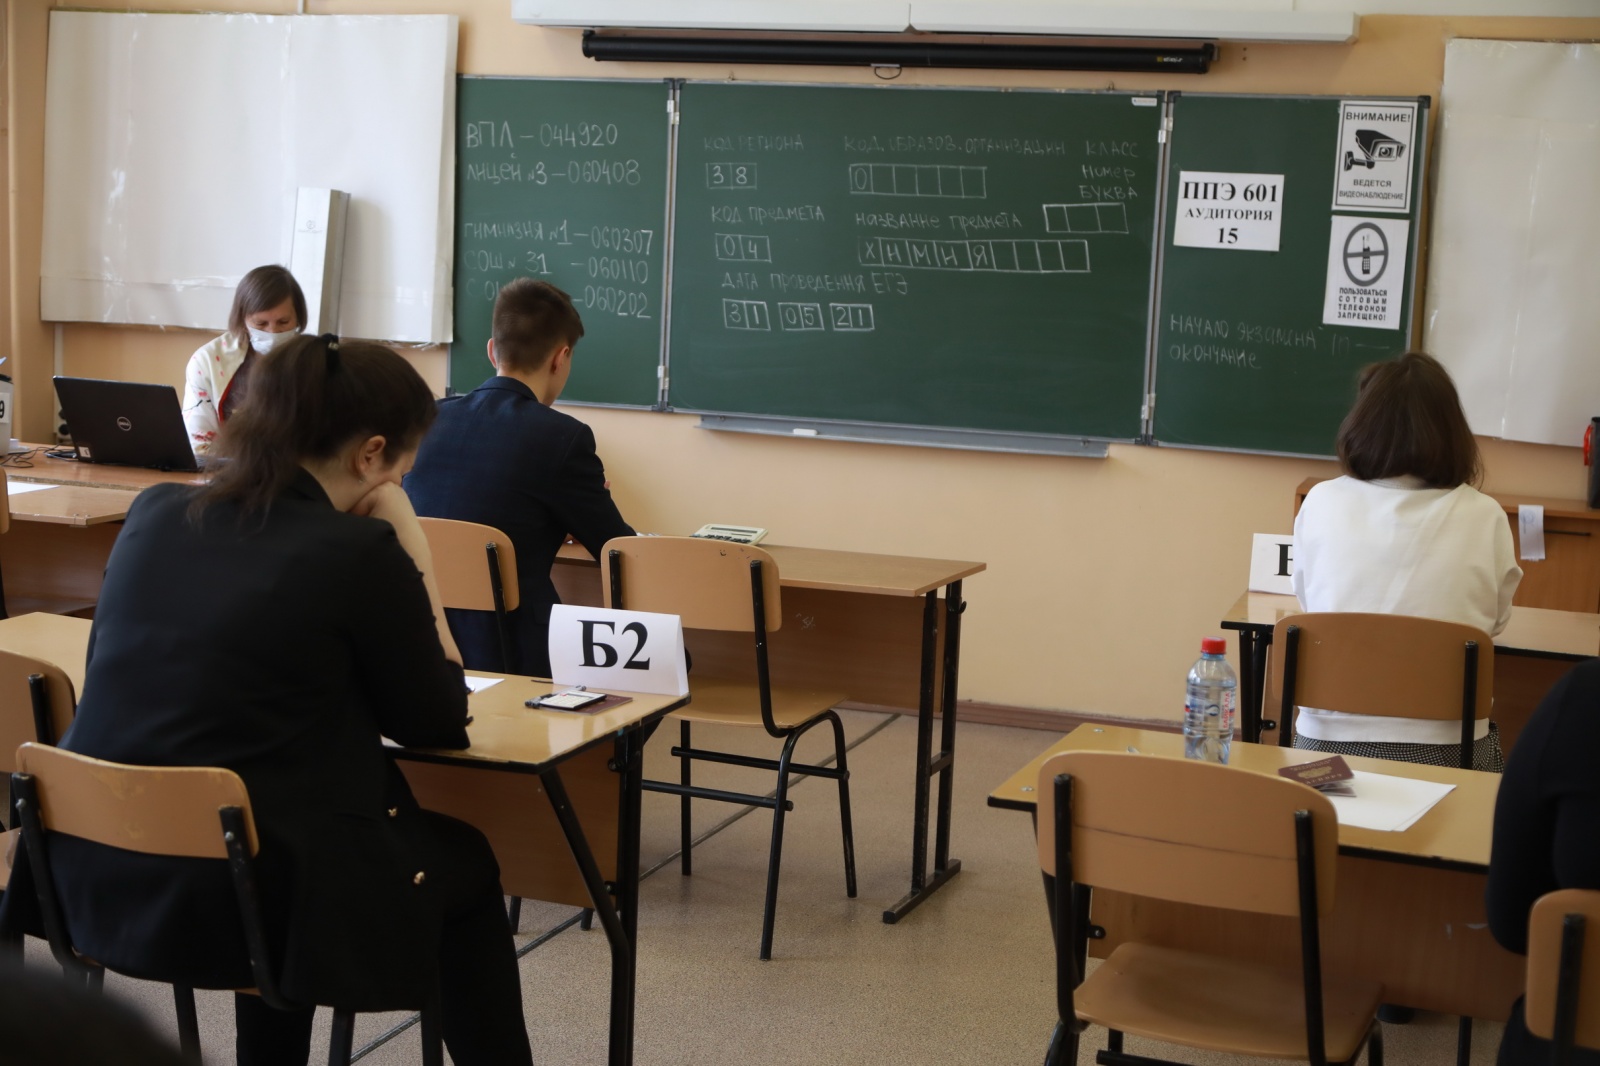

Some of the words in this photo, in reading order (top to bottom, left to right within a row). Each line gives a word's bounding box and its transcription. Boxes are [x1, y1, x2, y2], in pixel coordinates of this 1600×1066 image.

[1345, 111, 1410, 123] ВНИМАНИЕ!
[466, 120, 514, 148] ВПЛ
[738, 134, 804, 151] РЕГИОНА
[1085, 139, 1139, 158] КЛАСС
[1182, 181, 1236, 201] ППЭ
[1243, 182, 1278, 202] 601
[1353, 179, 1392, 187] ВЕДЕТСЯ
[1339, 190, 1405, 200] ВИДЕОНАБЛЮДЕНИЕ
[711, 205, 744, 225] КОД
[1185, 207, 1273, 221] АУДИТОРИЯ
[1218, 227, 1239, 244] 15
[464, 250, 503, 272] СОШ
[721, 272, 759, 291] ДАТА
[871, 271, 908, 295] ЕГЭ
[1338, 295, 1387, 305] СОТОВЫМ
[1339, 287, 1388, 297] ПОЛЬЗОВАТЬСЯ
[1337, 311, 1386, 321] ЗАПРЕЩЕНО!
[1338, 303, 1387, 313] ТЕЛЕФОНОМ
[1170, 313, 1229, 339] НАЧАЛО
[577, 619, 651, 671] Б2
